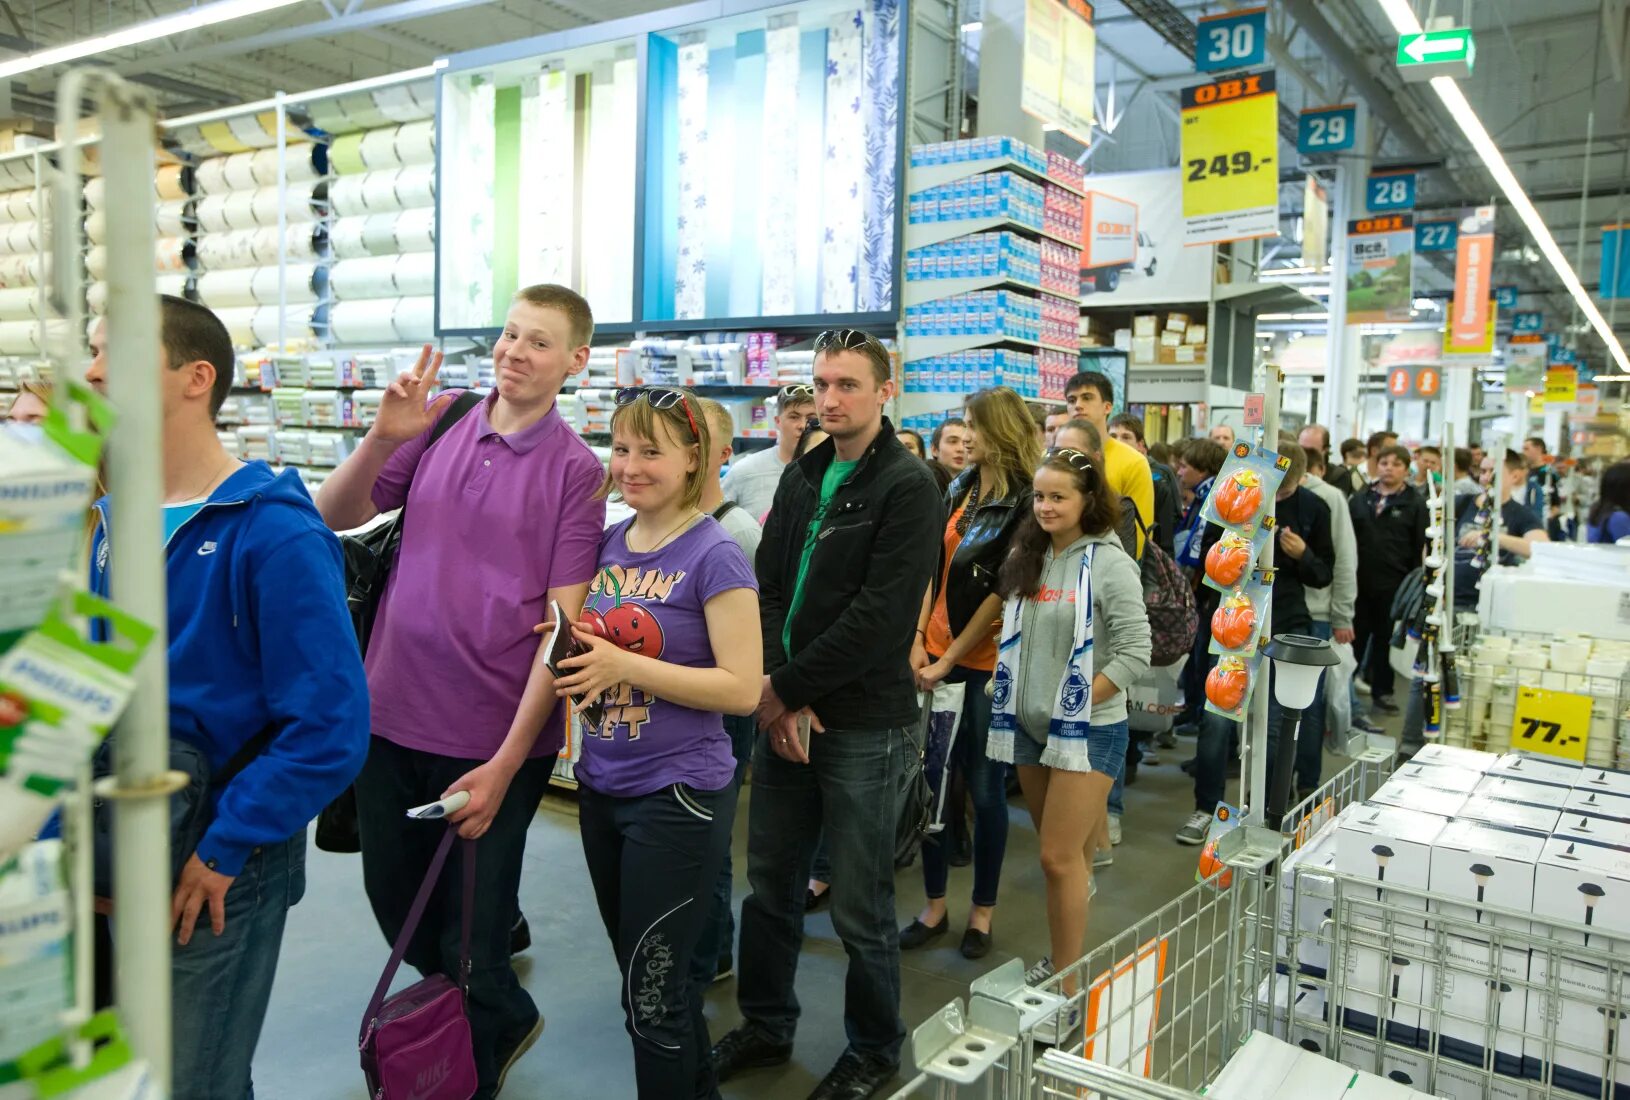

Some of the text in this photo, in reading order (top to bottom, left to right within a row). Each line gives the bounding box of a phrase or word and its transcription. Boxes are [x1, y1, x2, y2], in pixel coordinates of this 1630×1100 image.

[1208, 23, 1255, 62] 30
[1194, 75, 1262, 104] OBI
[1307, 115, 1346, 146] 29
[1374, 180, 1407, 205] 28
[1096, 221, 1132, 235] OBI
[1356, 215, 1404, 233] OBI
[1420, 225, 1450, 247] 27
[1517, 314, 1541, 331] 24
[1341, 1039, 1376, 1055] Светильни
[415, 1055, 451, 1090] NIKE
